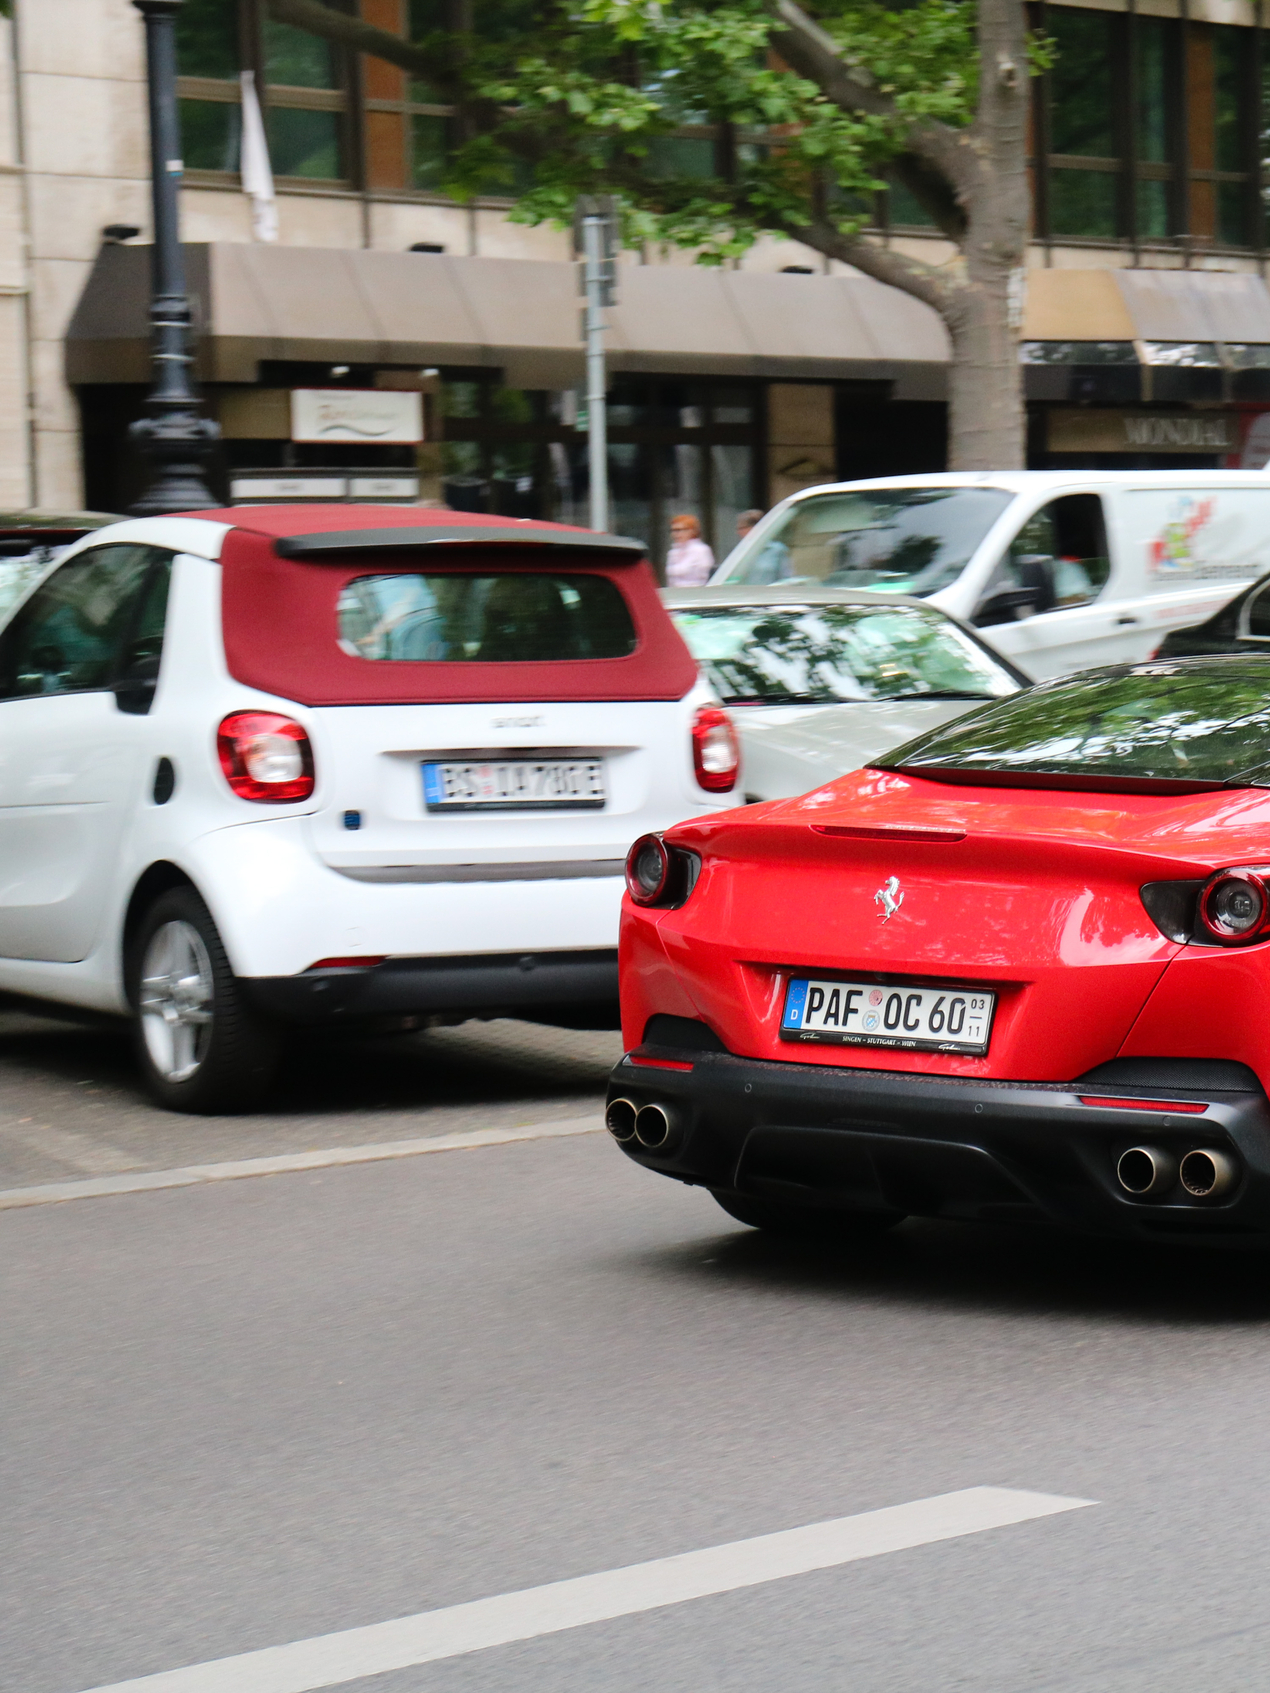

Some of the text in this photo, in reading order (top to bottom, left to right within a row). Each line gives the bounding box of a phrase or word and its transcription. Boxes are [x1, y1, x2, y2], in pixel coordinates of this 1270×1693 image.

[970, 998, 985, 1010] 03
[790, 1009, 798, 1021] D
[805, 987, 966, 1035] PAF OC 60
[968, 1025, 981, 1037] 11
[842, 1035, 863, 1043] SINGEN
[867, 1037, 897, 1046] STUTTGART
